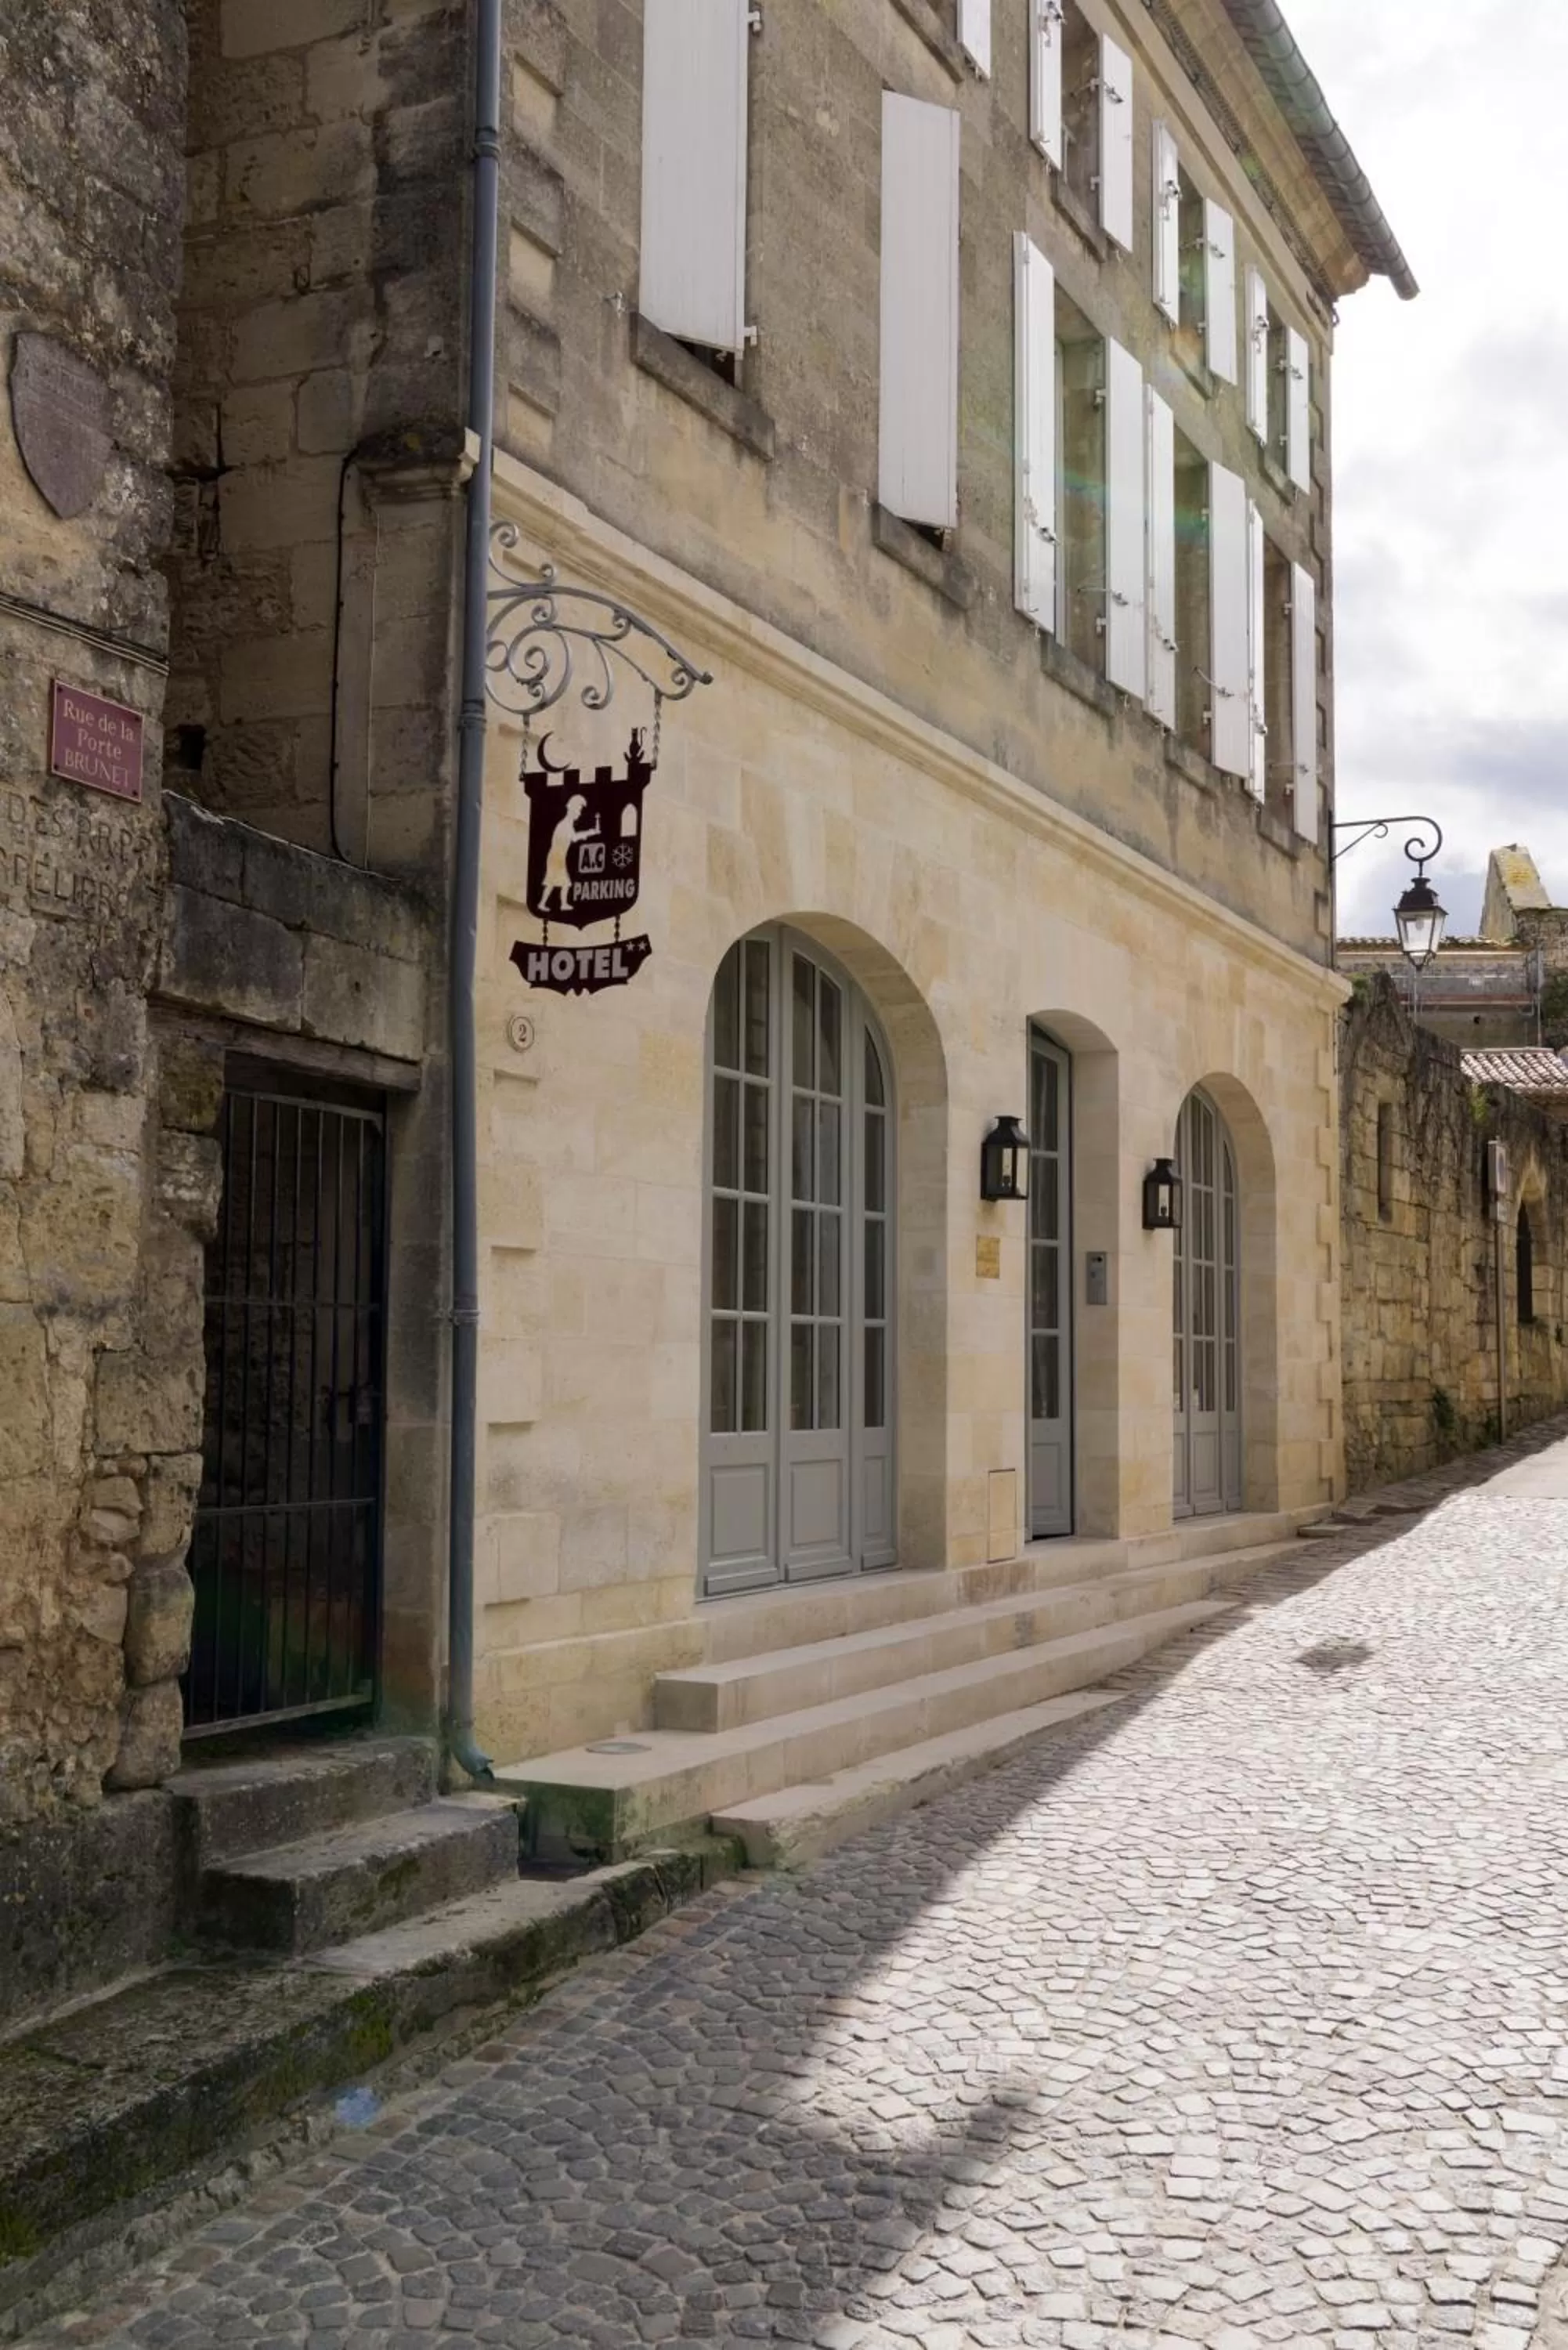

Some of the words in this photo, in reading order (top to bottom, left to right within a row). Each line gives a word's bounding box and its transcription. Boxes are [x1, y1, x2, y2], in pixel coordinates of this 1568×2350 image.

[63, 699, 95, 727] Rue
[98, 714, 117, 736] de
[121, 721, 135, 741] la
[77, 728, 122, 760] Porte
[64, 747, 128, 787] BRUNET
[573, 878, 635, 902] PARKING
[527, 949, 629, 982] HOTEL
[518, 1024, 528, 1043] 2
